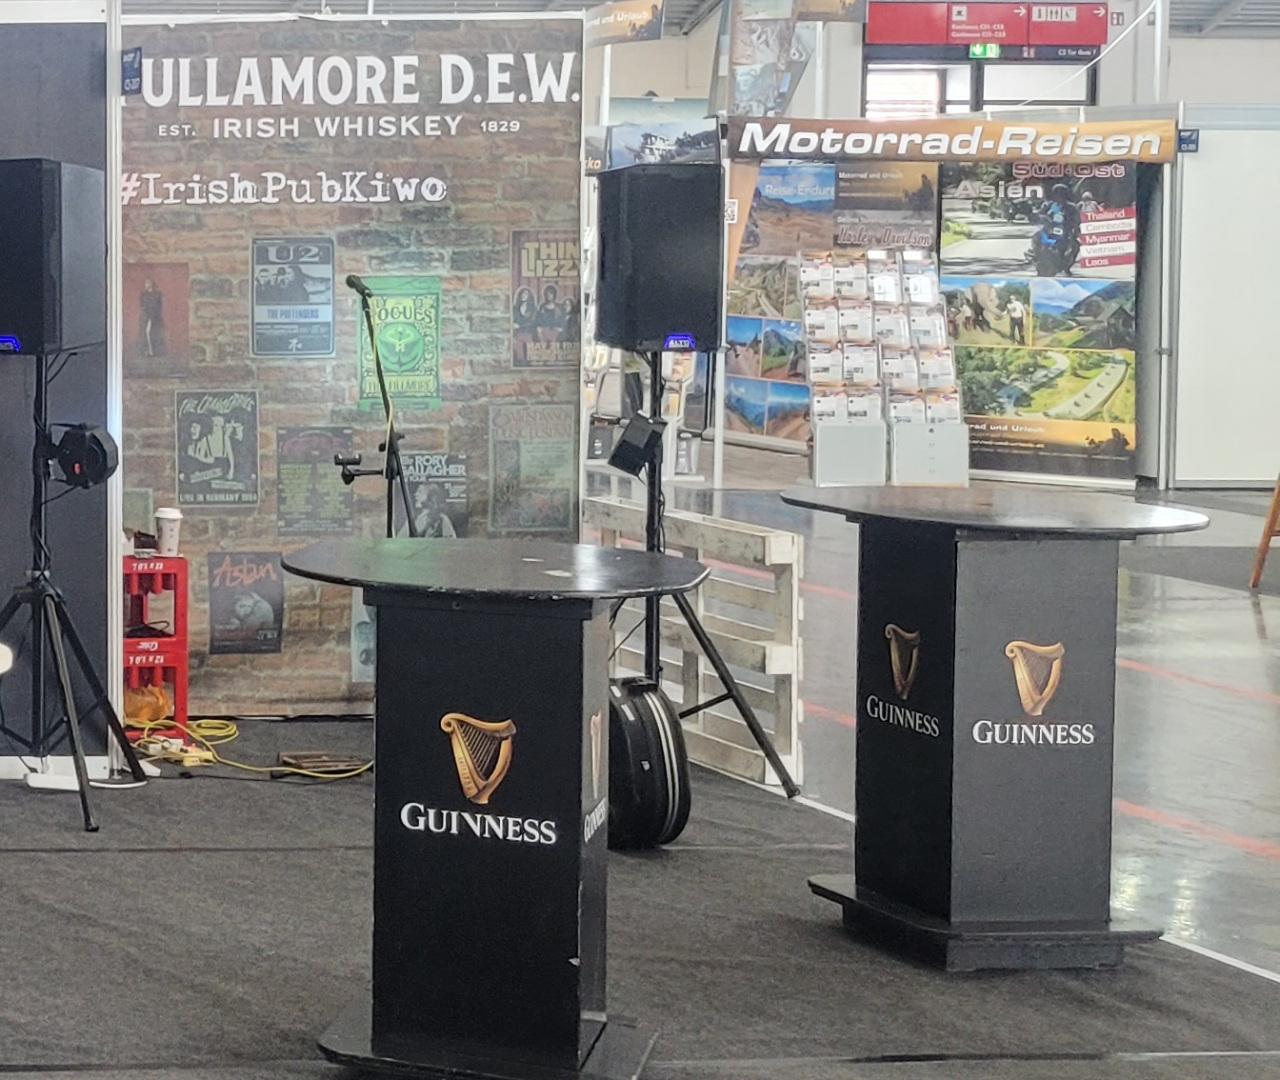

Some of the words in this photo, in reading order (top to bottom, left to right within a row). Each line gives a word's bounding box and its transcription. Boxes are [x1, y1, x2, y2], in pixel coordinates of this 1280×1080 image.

[121, 55, 420, 108] ULLAMORE
[439, 51, 581, 105] D.E.W.
[158, 124, 197, 138] EST.
[213, 117, 300, 139] IRISH
[313, 114, 464, 138] WHISKEY
[480, 120, 521, 133] 1829
[738, 122, 1161, 157] Motorrad-Reisen
[120, 170, 448, 206] #IrishPubKiwo
[955, 180, 1044, 199] Asien
[1085, 209, 1126, 220] Thailand
[1085, 232, 1132, 245] Myanmar
[267, 245, 321, 264] U2
[377, 306, 434, 324] OGUES
[865, 694, 940, 738] GUINNESS
[972, 720, 1095, 745] GUINNESS
[399, 801, 558, 846] GUINNESS
